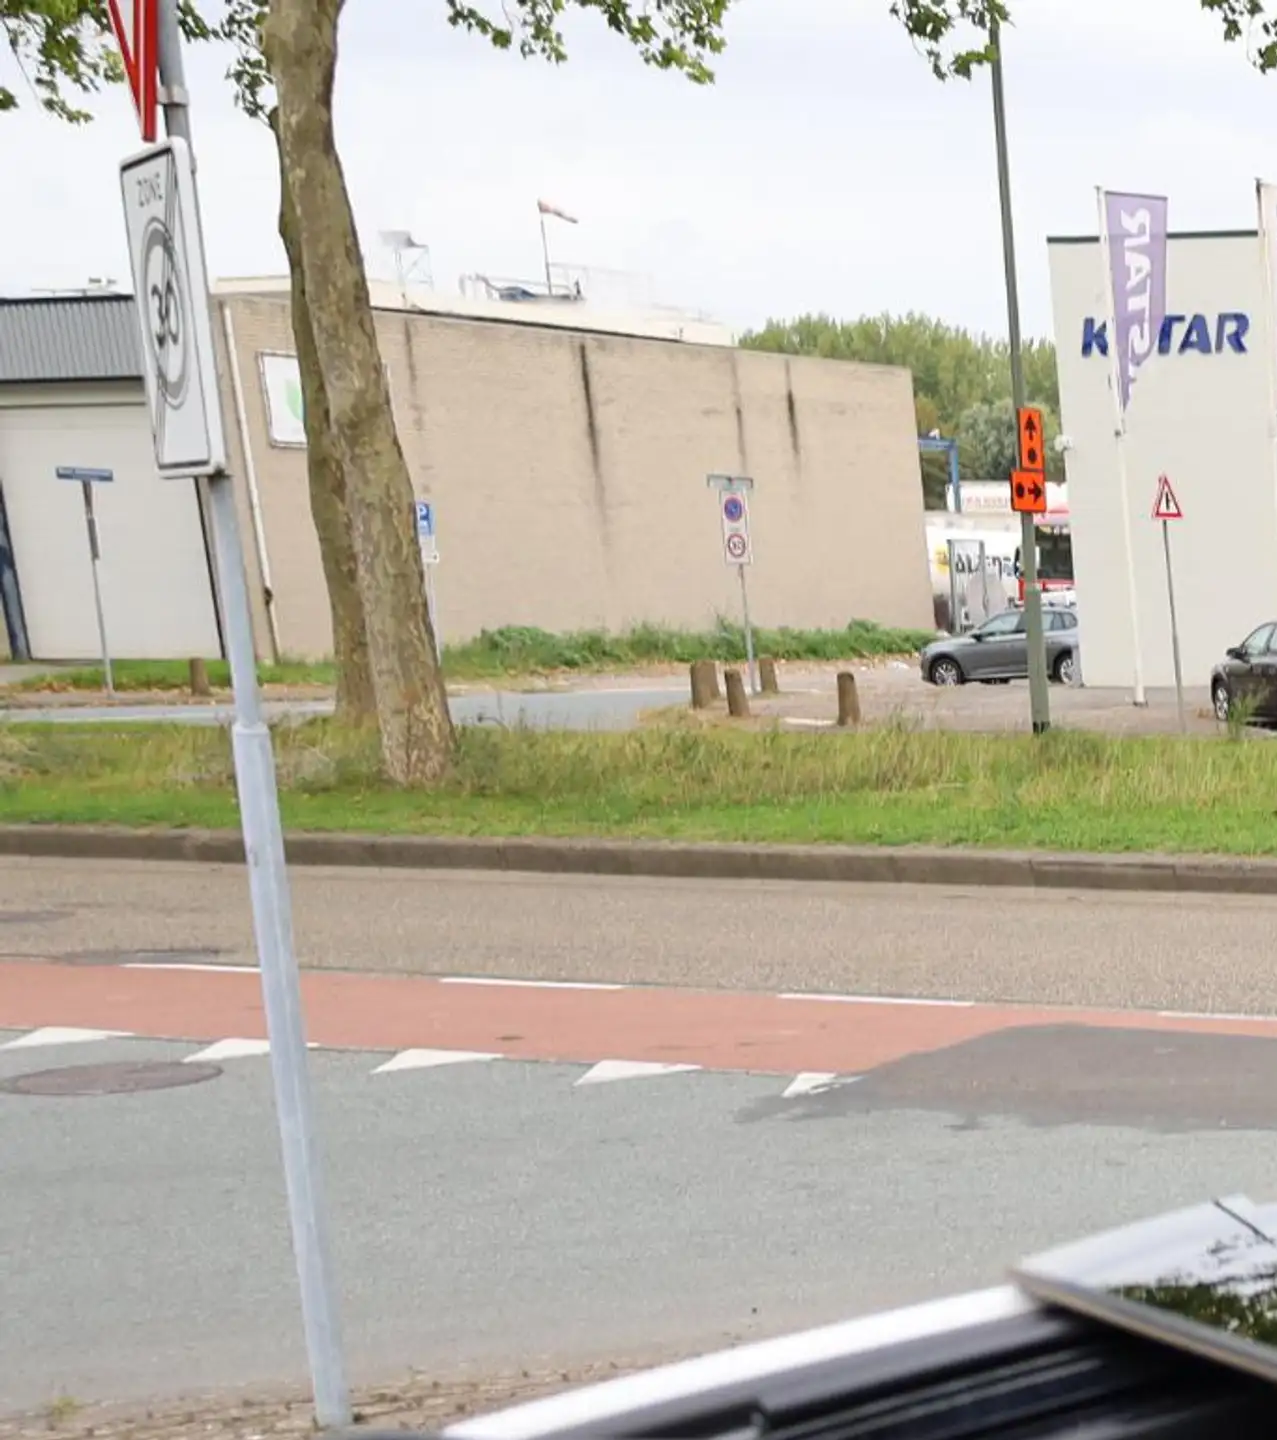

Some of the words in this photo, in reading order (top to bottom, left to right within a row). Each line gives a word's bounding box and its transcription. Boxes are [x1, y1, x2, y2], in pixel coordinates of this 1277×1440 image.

[137, 172, 163, 207] ZONE
[151, 280, 181, 348] 30
[1081, 313, 1250, 358] KTAR
